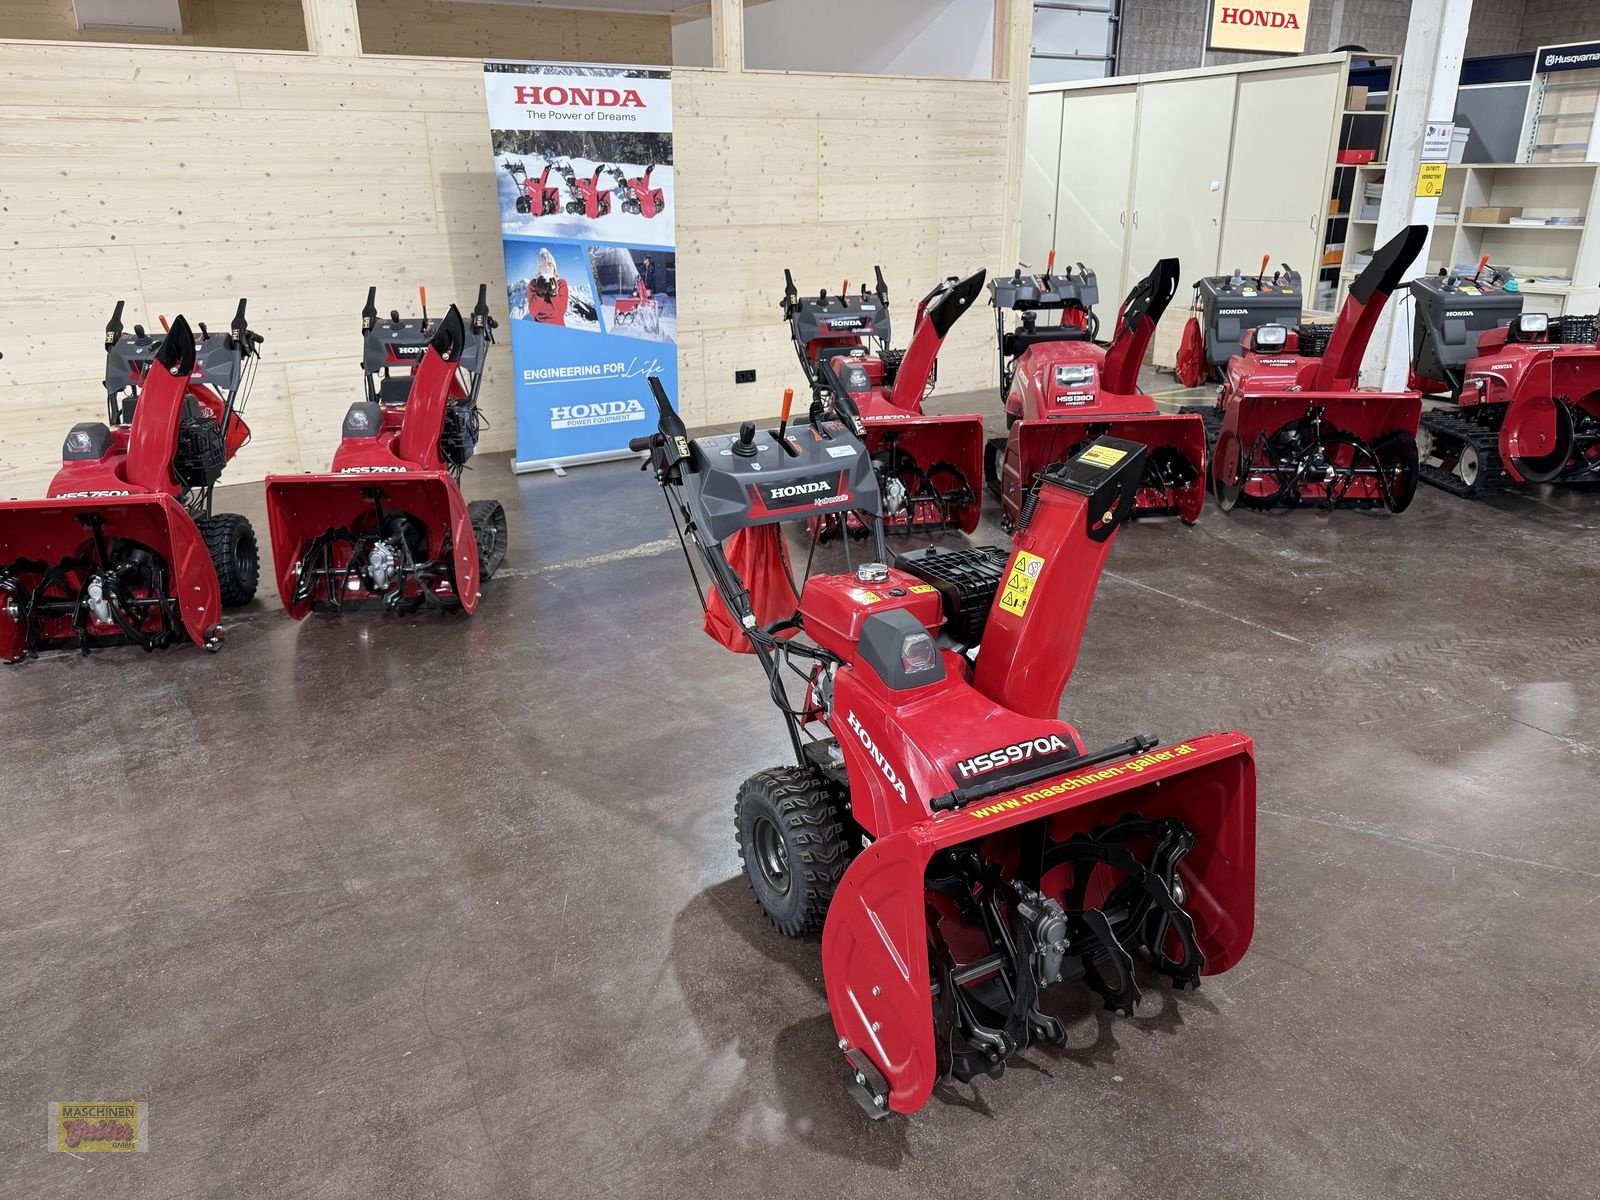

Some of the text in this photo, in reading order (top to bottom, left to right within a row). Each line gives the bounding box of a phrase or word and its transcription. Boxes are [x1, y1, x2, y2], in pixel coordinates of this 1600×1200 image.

[1220, 7, 1300, 30] HONDA
[1554, 52, 1600, 65] Husqvarna
[513, 85, 647, 108] HONDA
[526, 110, 637, 122] The Power of Dreams
[523, 356, 665, 381] ENGINEERING FOR Life
[1490, 363, 1513, 371] HONDA
[549, 399, 646, 421] HONDA
[566, 413, 631, 427] POWER EQUIPMENT
[770, 480, 832, 499] HONDA
[846, 708, 908, 805] HONDA
[956, 733, 1068, 778] HSS970A
[969, 744, 1197, 820] www.maschinen-gailer.at
